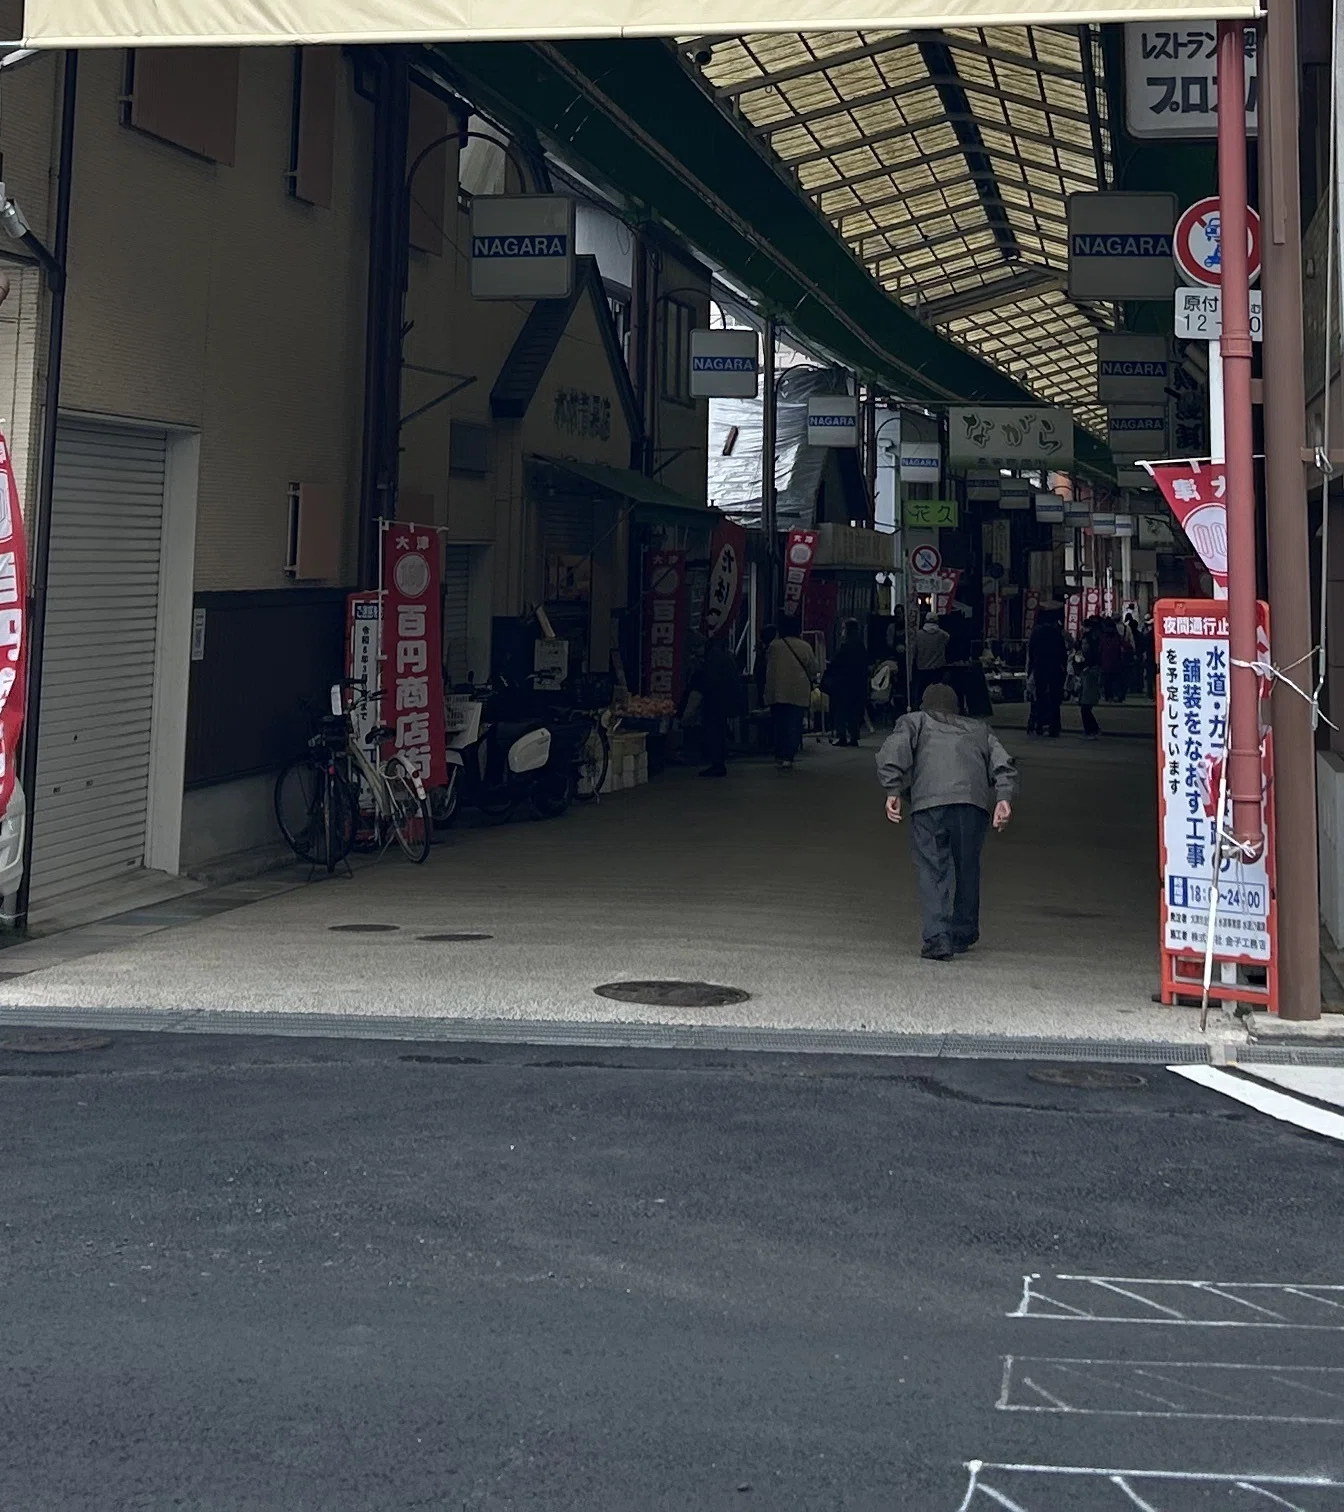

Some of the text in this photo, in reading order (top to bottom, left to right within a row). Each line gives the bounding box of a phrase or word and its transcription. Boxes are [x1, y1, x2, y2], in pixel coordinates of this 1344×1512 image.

[1146, 76, 1256, 114] プロ
[473, 237, 564, 256] NAGARA
[1073, 237, 1170, 255] NAGARA
[1184, 295, 1261, 314] 原付む
[1184, 314, 1261, 333] 12-0
[693, 356, 754, 371] NAGARA
[1102, 362, 1165, 375] NAGARA
[809, 415, 855, 427] NAGARA
[1111, 417, 1164, 430] NAGARA
[962, 413, 1062, 456] ながら
[901, 457, 939, 468] NAGARA
[909, 504, 953, 524] 花久
[1163, 616, 1229, 636] 夜間通行止
[1166, 648, 1181, 795] を予定しています
[1182, 657, 1205, 869] 舗装をなおす工事
